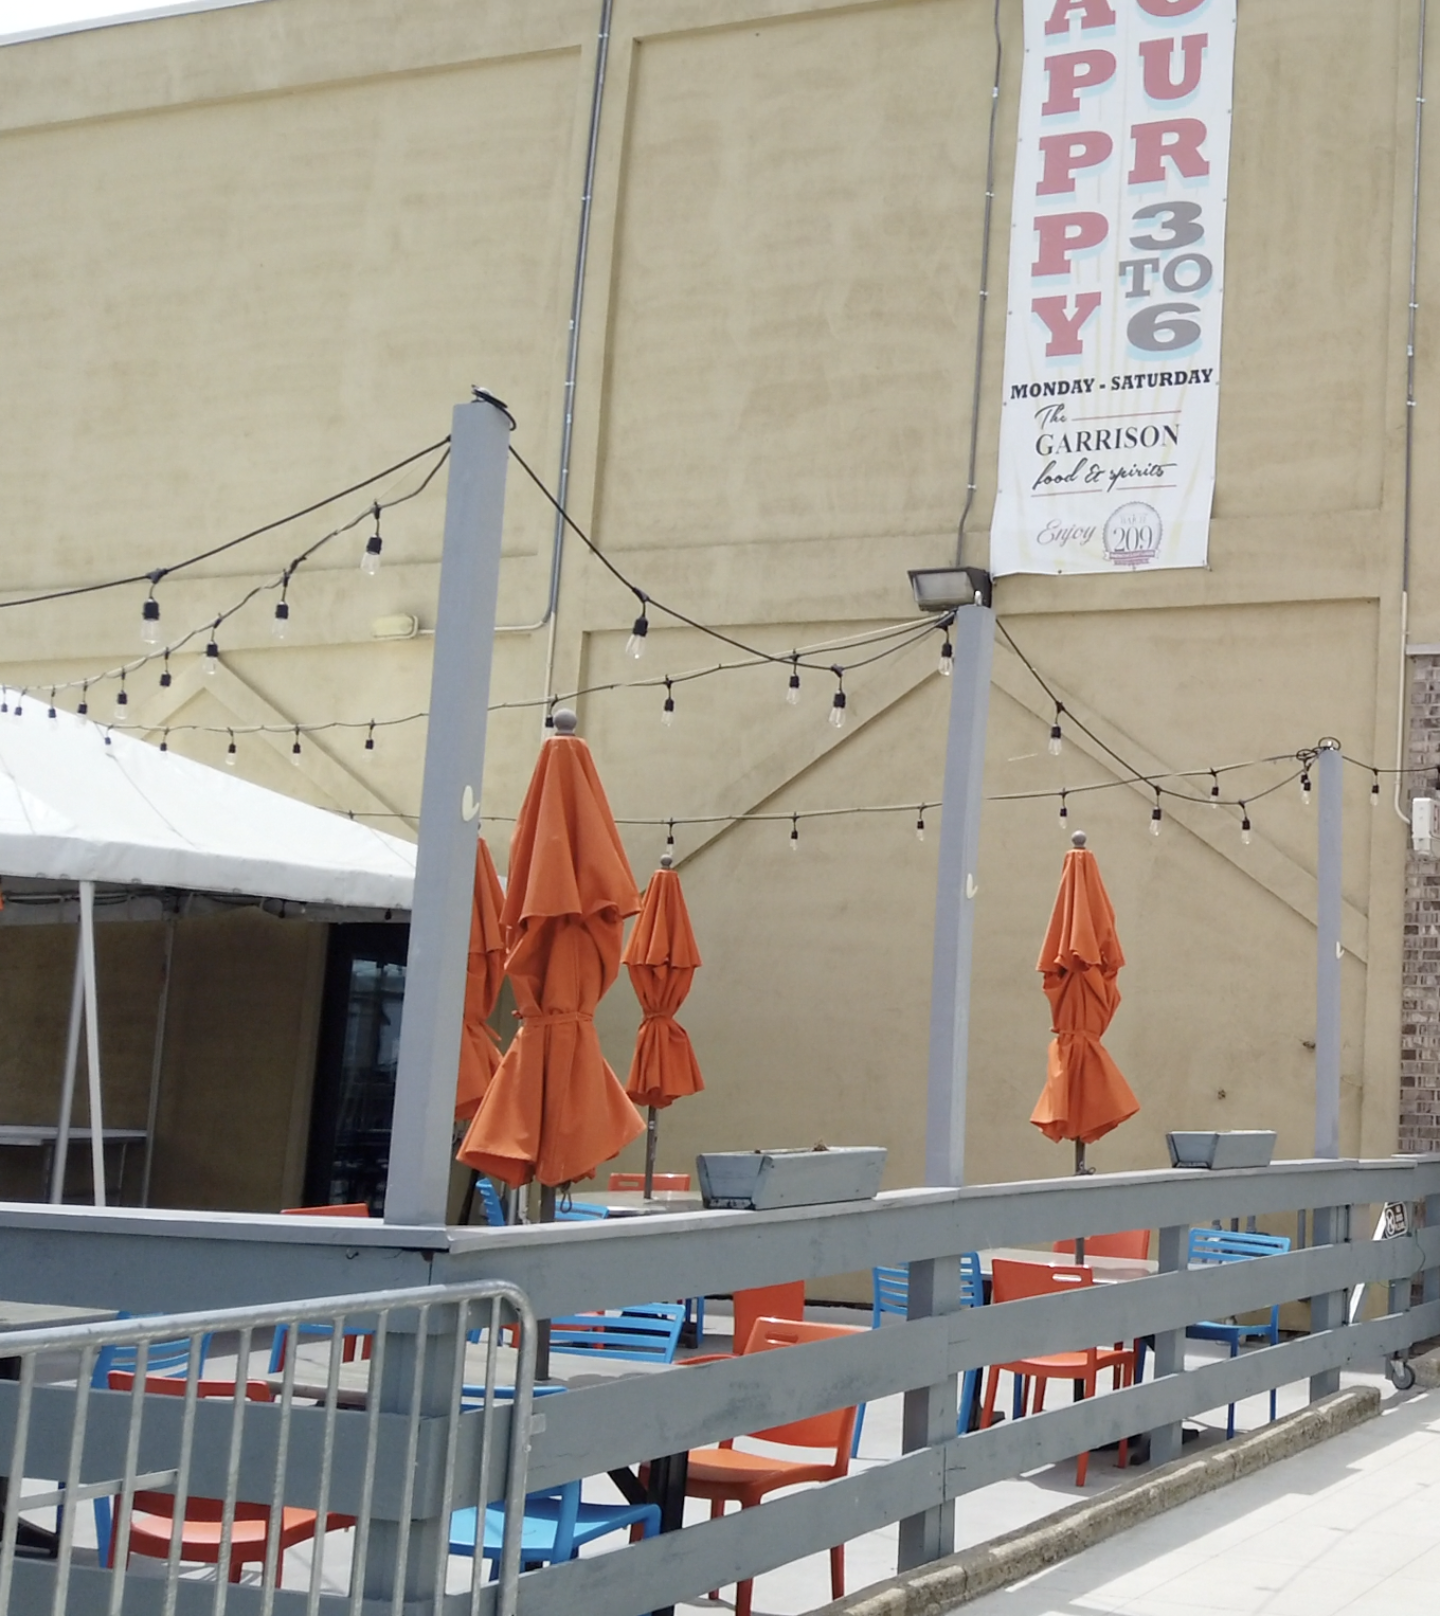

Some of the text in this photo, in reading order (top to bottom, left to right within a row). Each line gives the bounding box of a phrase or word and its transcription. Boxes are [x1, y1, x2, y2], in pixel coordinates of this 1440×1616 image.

[1119, 201, 1213, 352] 3 TO 6
[1010, 378, 1095, 399] MONDAY
[1111, 368, 1213, 391] SATURDAY
[1034, 403, 1067, 430] The
[1036, 424, 1180, 456] GARRISON
[1032, 457, 1177, 492] food & spirits
[1037, 518, 1097, 547] Enjoy
[1113, 526, 1153, 552] 209
